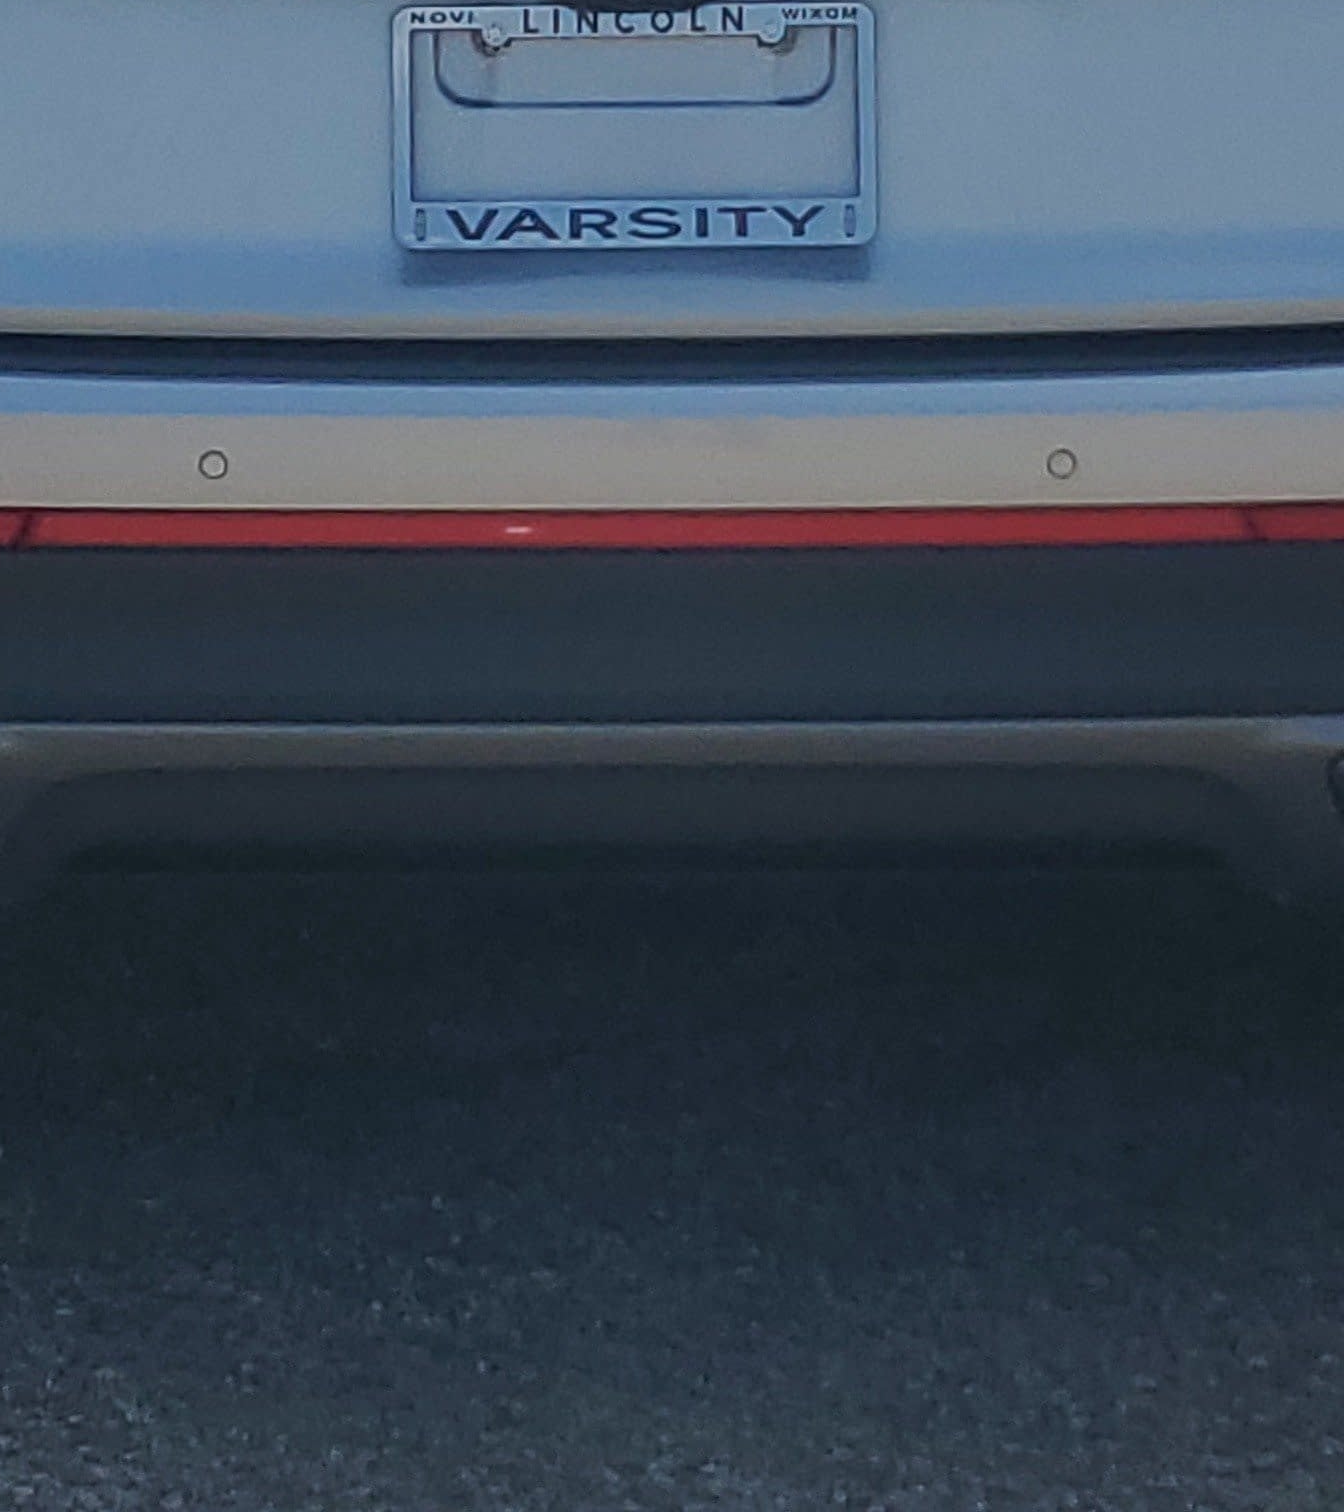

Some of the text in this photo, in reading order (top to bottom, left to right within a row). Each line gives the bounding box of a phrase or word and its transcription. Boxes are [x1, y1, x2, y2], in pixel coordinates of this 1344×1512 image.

[410, 12, 474, 24] NOVI
[523, 6, 745, 34] LINCOLN
[782, 7, 857, 20] WIXOM
[445, 206, 824, 241] VARSITY
